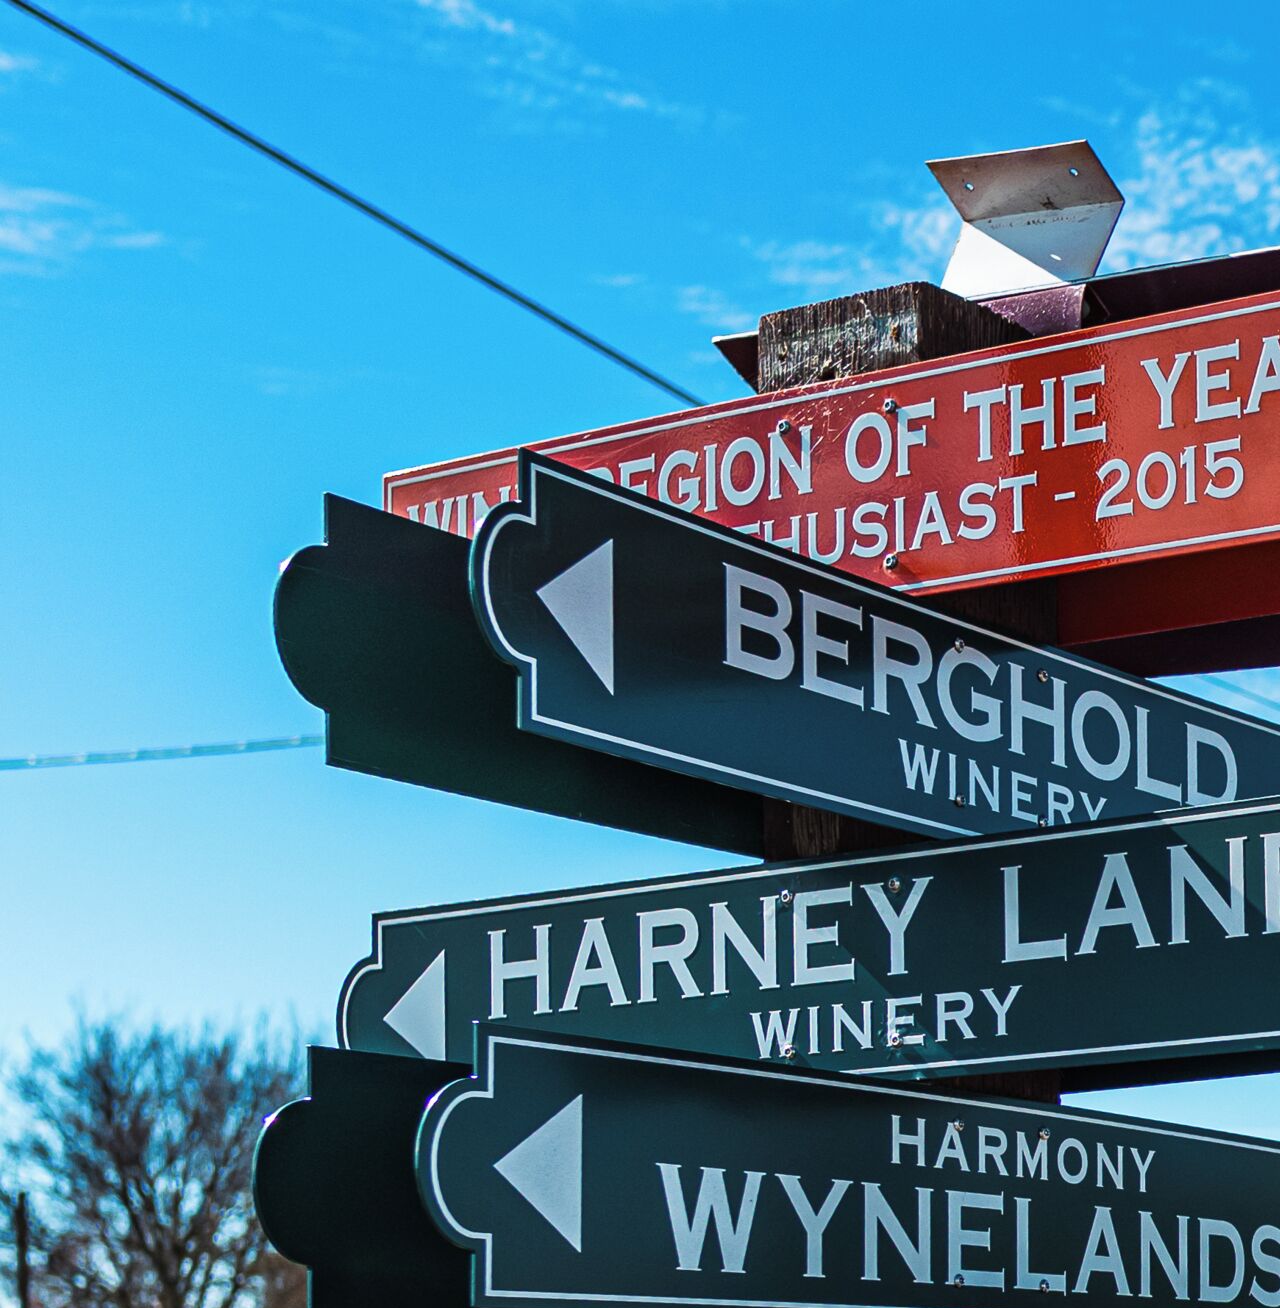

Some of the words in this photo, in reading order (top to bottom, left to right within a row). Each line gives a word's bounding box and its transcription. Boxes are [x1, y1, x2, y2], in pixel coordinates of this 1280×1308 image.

[584, 424, 813, 513] EGION
[845, 397, 936, 484] OF
[964, 364, 1106, 462] THE
[1095, 435, 1245, 520] 2015
[721, 562, 1239, 805] BERGHOLD
[898, 738, 1108, 826] WINERY
[486, 876, 933, 1020] HARNEY
[749, 984, 1022, 1060] WINERY
[891, 1114, 1156, 1192] HARMONY
